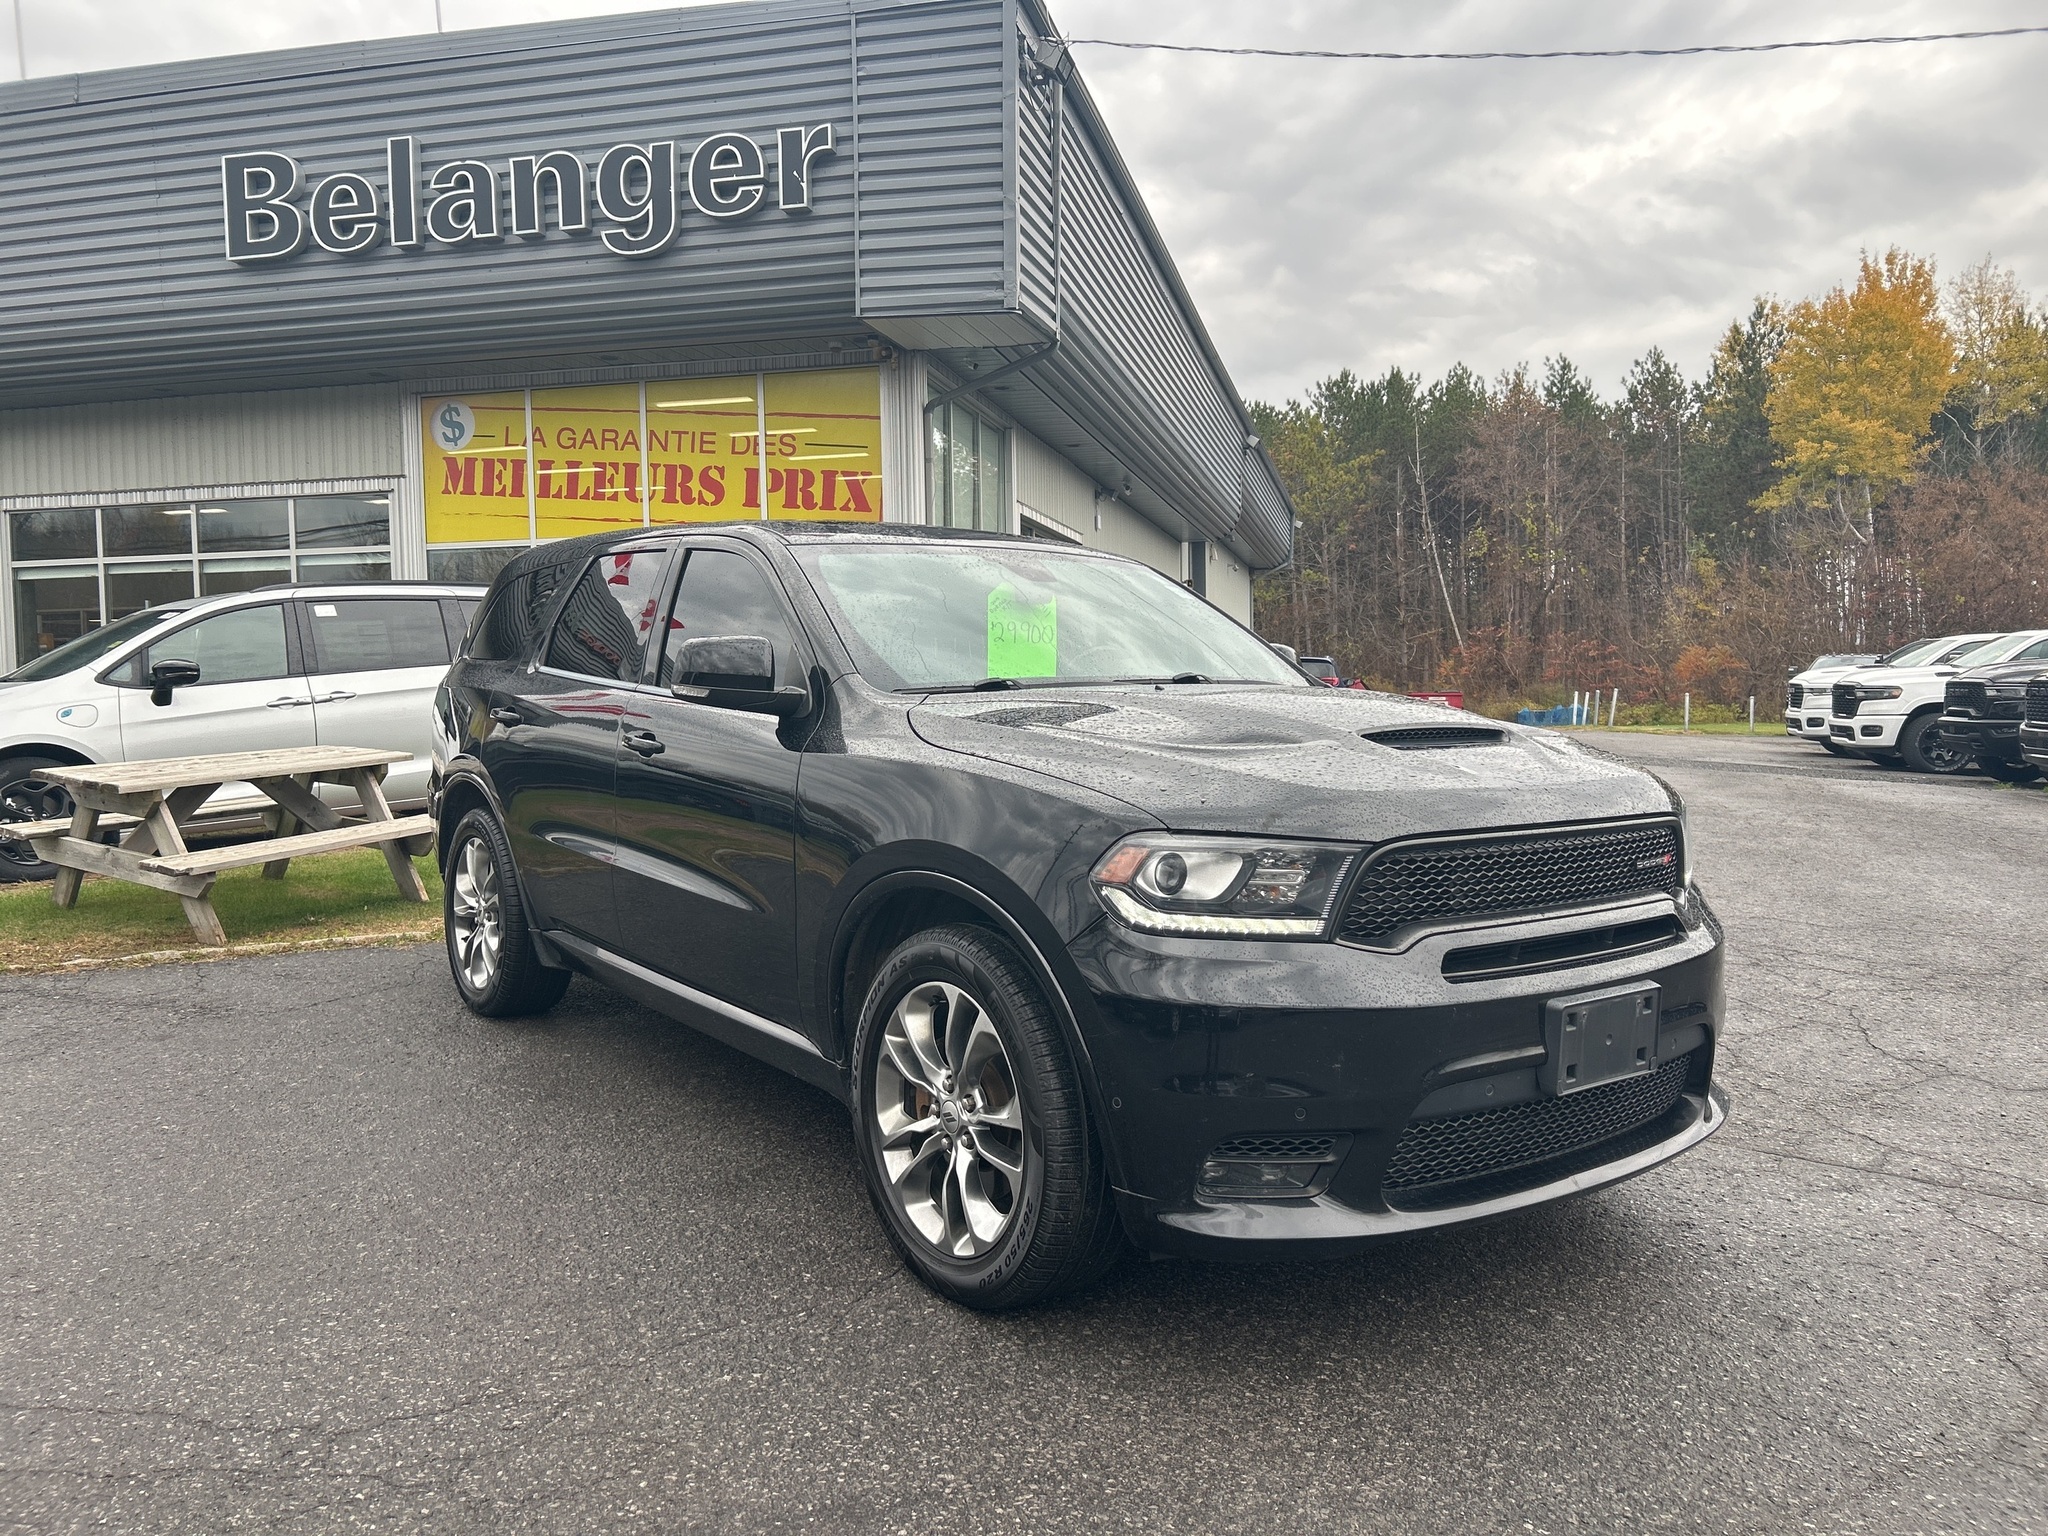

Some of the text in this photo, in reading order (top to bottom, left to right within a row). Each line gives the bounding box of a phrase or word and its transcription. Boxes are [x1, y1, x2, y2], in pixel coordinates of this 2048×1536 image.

[220, 122, 838, 264] Belanger
[504, 426, 797, 457] LA GARANTIE DES
[441, 456, 873, 512] MEILLEURS PRIX
